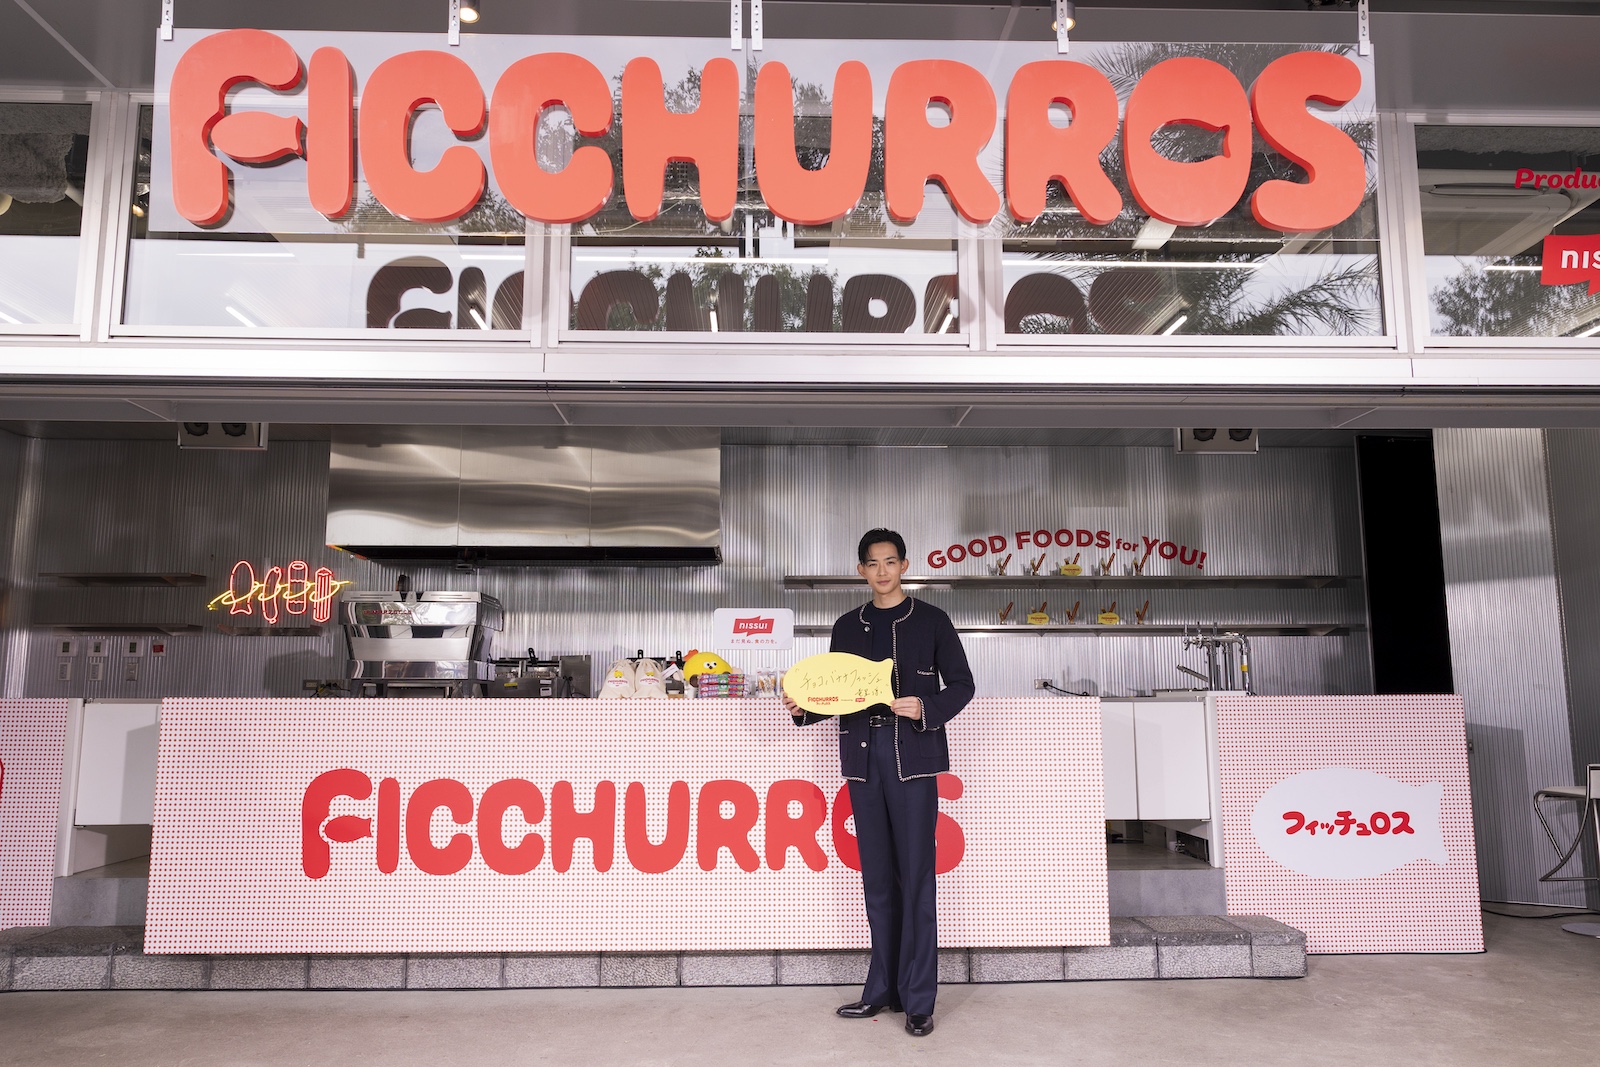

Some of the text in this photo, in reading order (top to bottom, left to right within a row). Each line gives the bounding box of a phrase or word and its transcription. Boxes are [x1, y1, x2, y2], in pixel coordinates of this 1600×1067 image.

[169, 28, 1366, 232] FICCHURROS
[1514, 167, 1600, 189] Produ
[927, 529, 1207, 570] GOOD FOODS for YOU!
[1282, 810, 1415, 836] フィッチュロス
